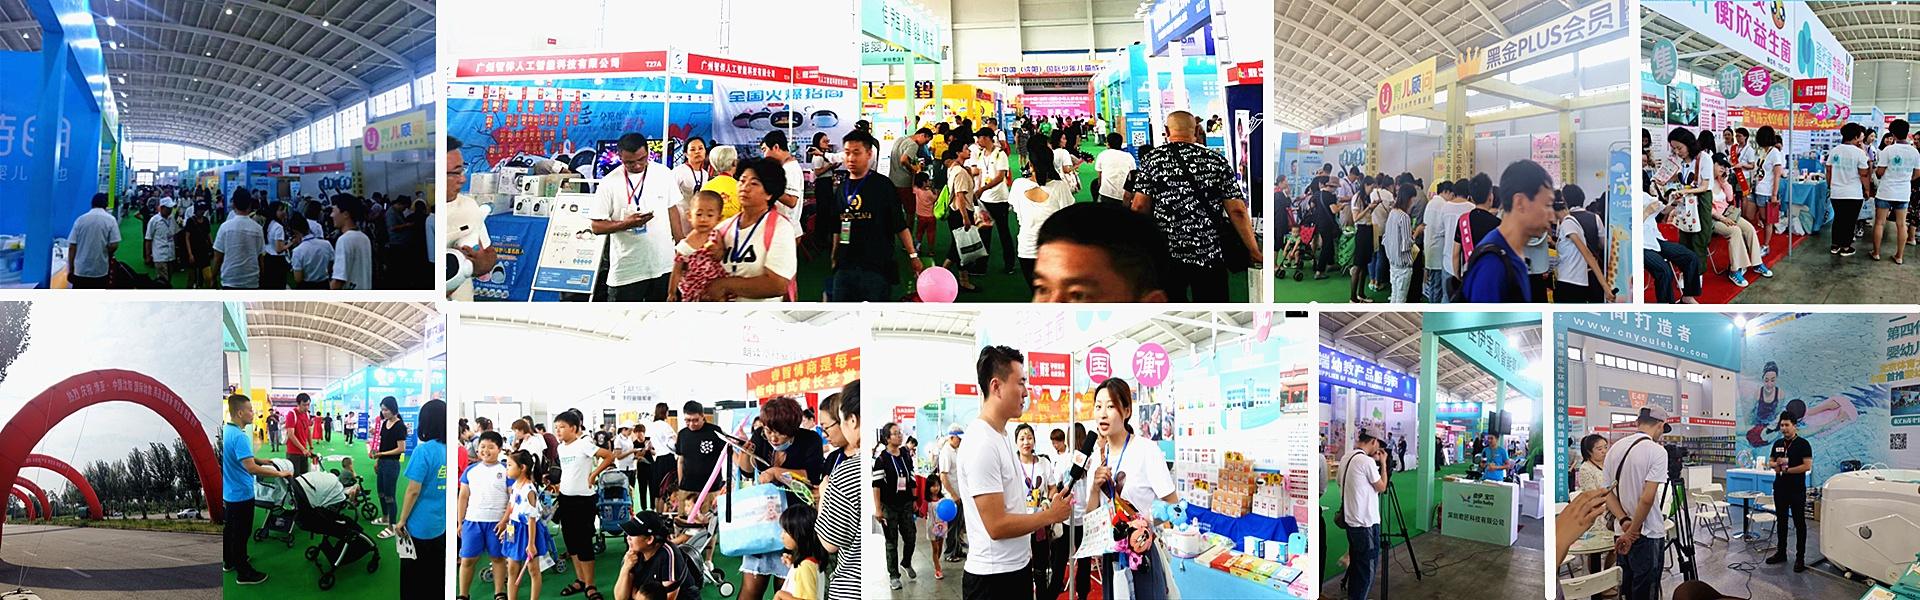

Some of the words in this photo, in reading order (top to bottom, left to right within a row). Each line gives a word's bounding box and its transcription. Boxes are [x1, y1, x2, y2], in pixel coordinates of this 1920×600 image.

[1486, 2, 1614, 70] 黑金PLUS会员
[1714, 0, 1792, 64] 衡欣益生菌
[1654, 46, 1673, 79] 集
[1722, 69, 1739, 95] 新
[1747, 69, 1767, 93] 零
[1588, 311, 1692, 344] 间打造者
[1135, 351, 1166, 380] 衡
